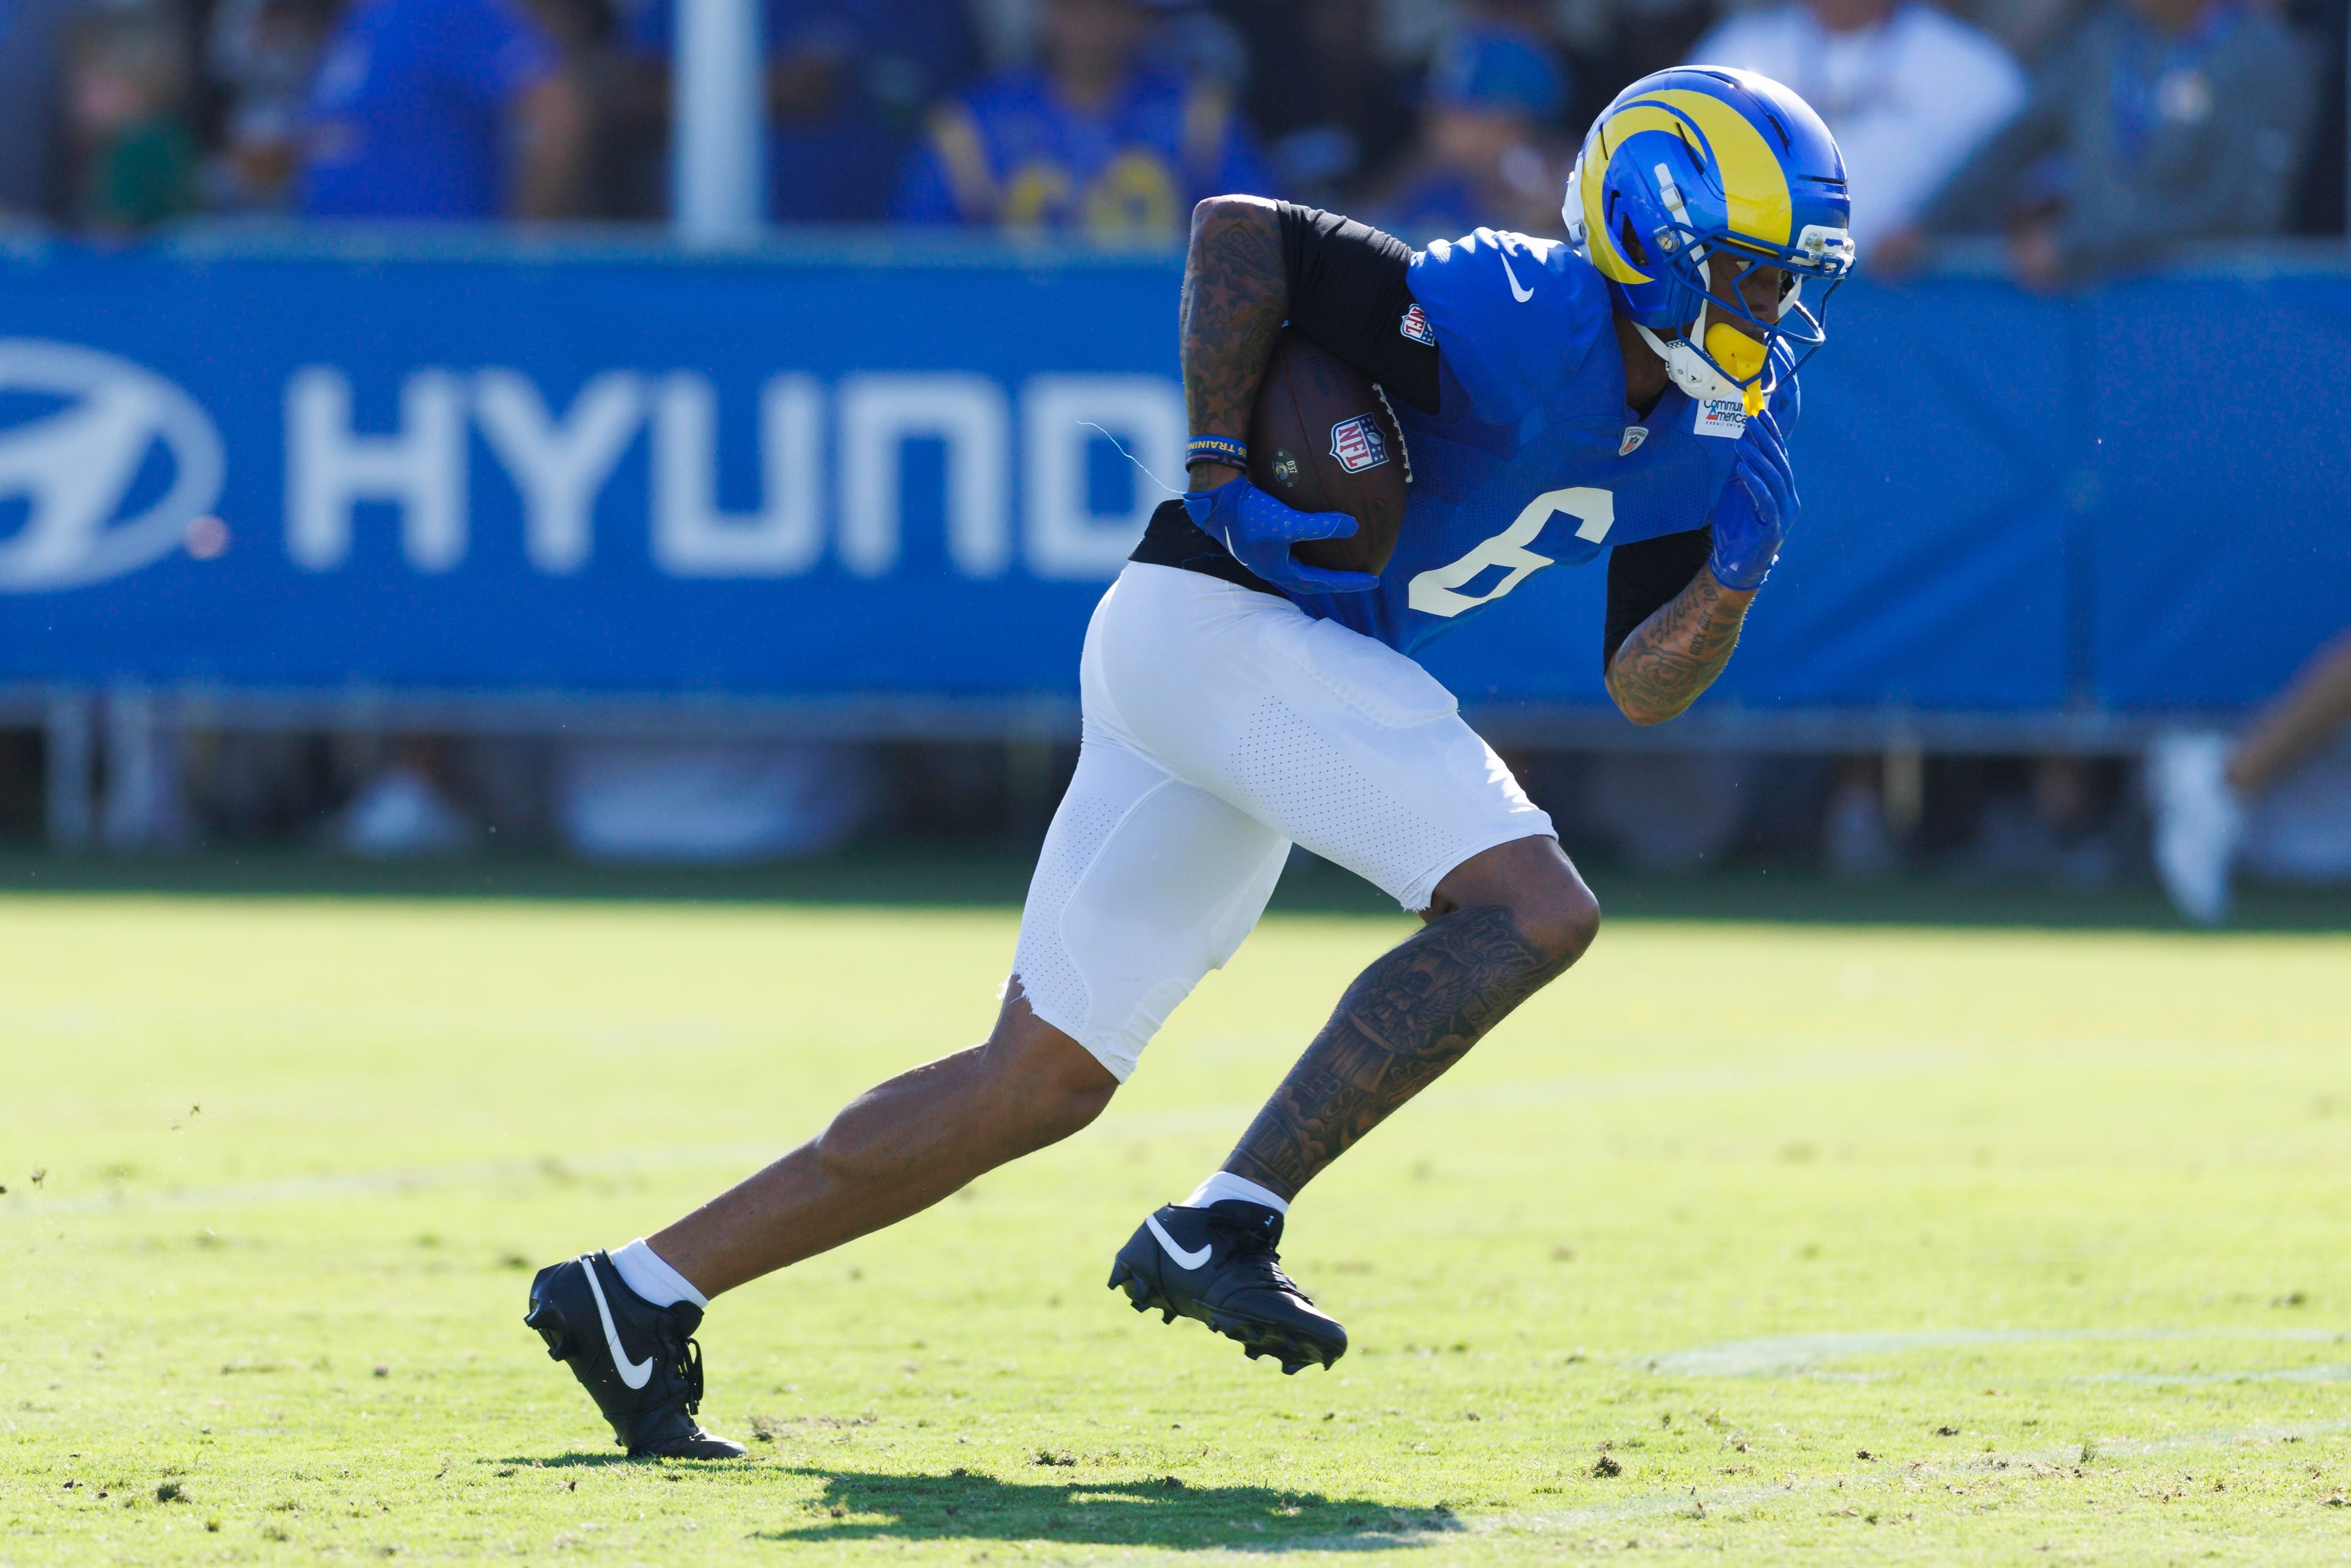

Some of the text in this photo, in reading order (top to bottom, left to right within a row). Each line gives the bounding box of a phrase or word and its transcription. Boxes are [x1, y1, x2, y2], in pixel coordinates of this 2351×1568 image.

[1404, 306, 1425, 334] NFL
[1338, 422, 1370, 468] NFL
[1408, 487, 1615, 618] 6
